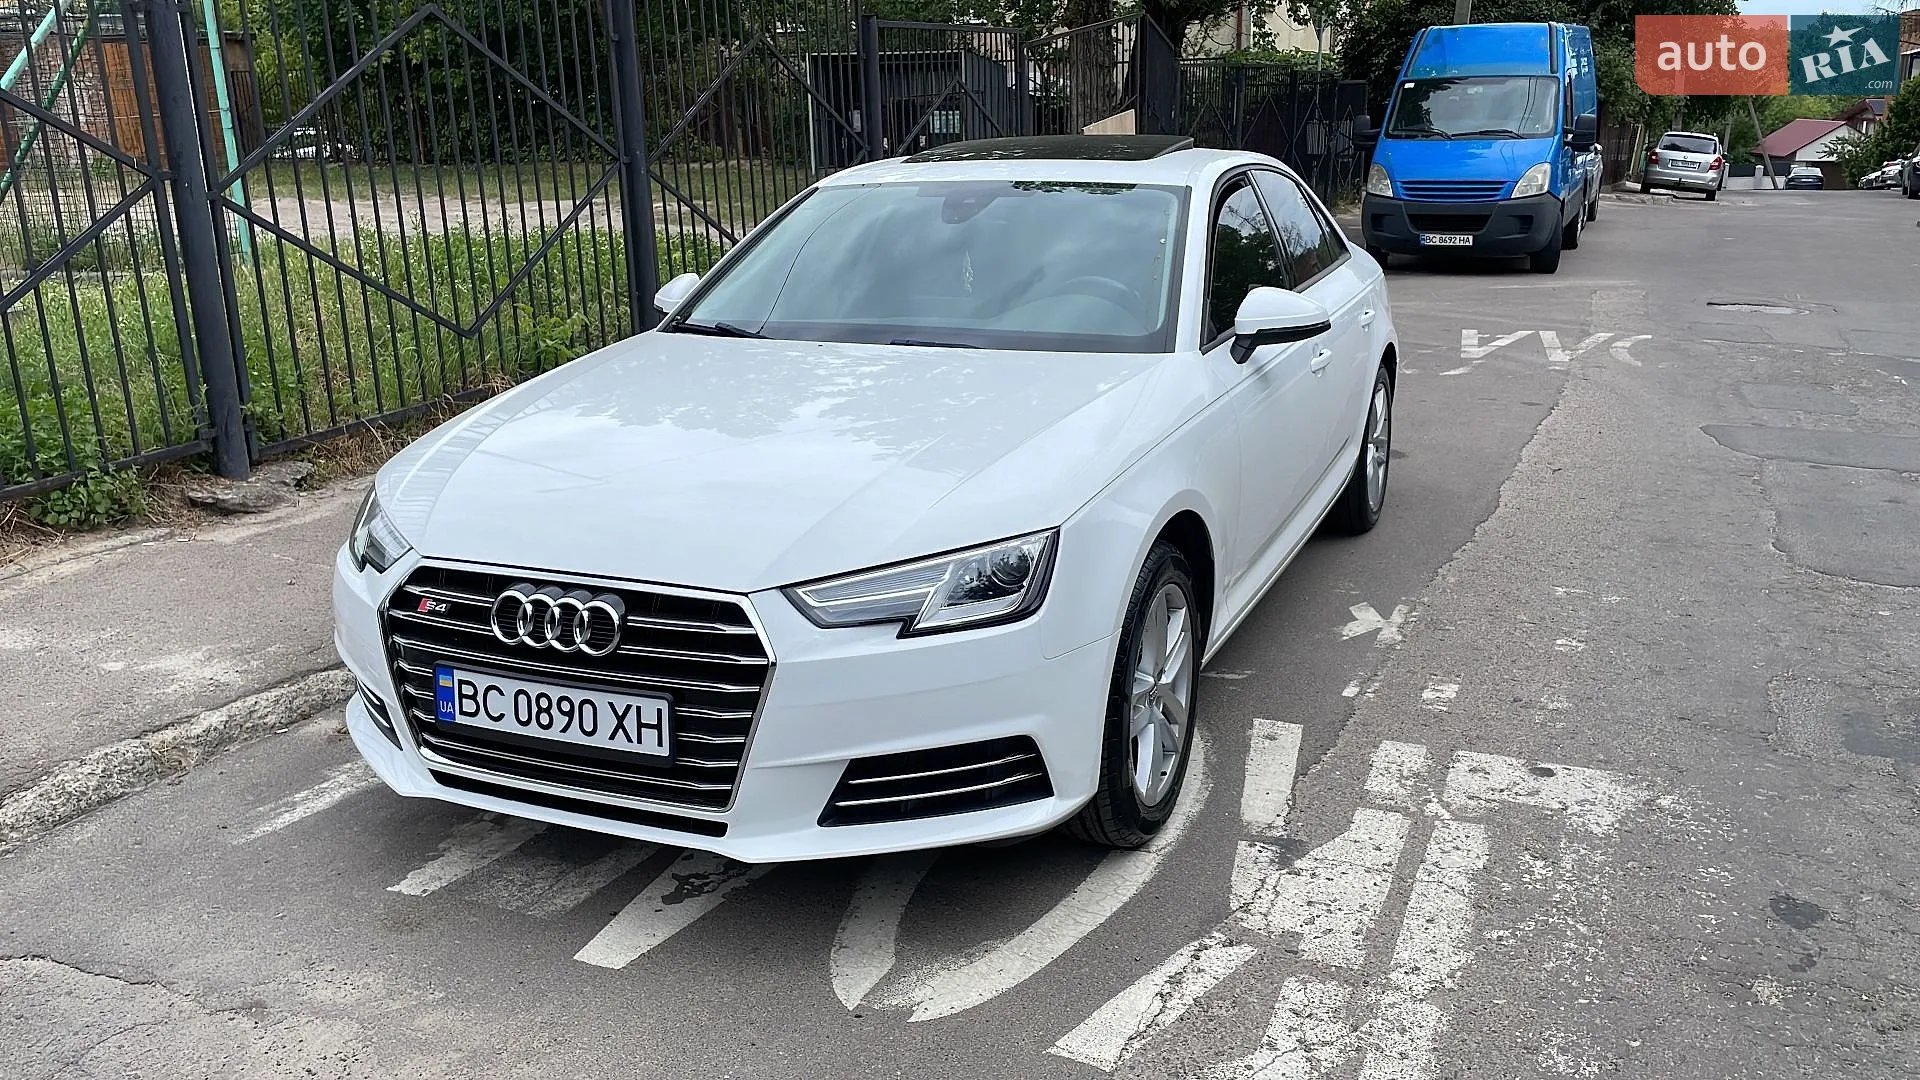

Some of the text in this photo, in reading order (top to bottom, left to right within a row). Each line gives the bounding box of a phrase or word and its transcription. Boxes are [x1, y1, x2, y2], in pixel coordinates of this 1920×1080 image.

[1425, 235, 1471, 245] BC 8692 HA
[425, 600, 447, 612] S4
[440, 700, 455, 714] UA
[457, 678, 664, 748] BC 0890 XH
